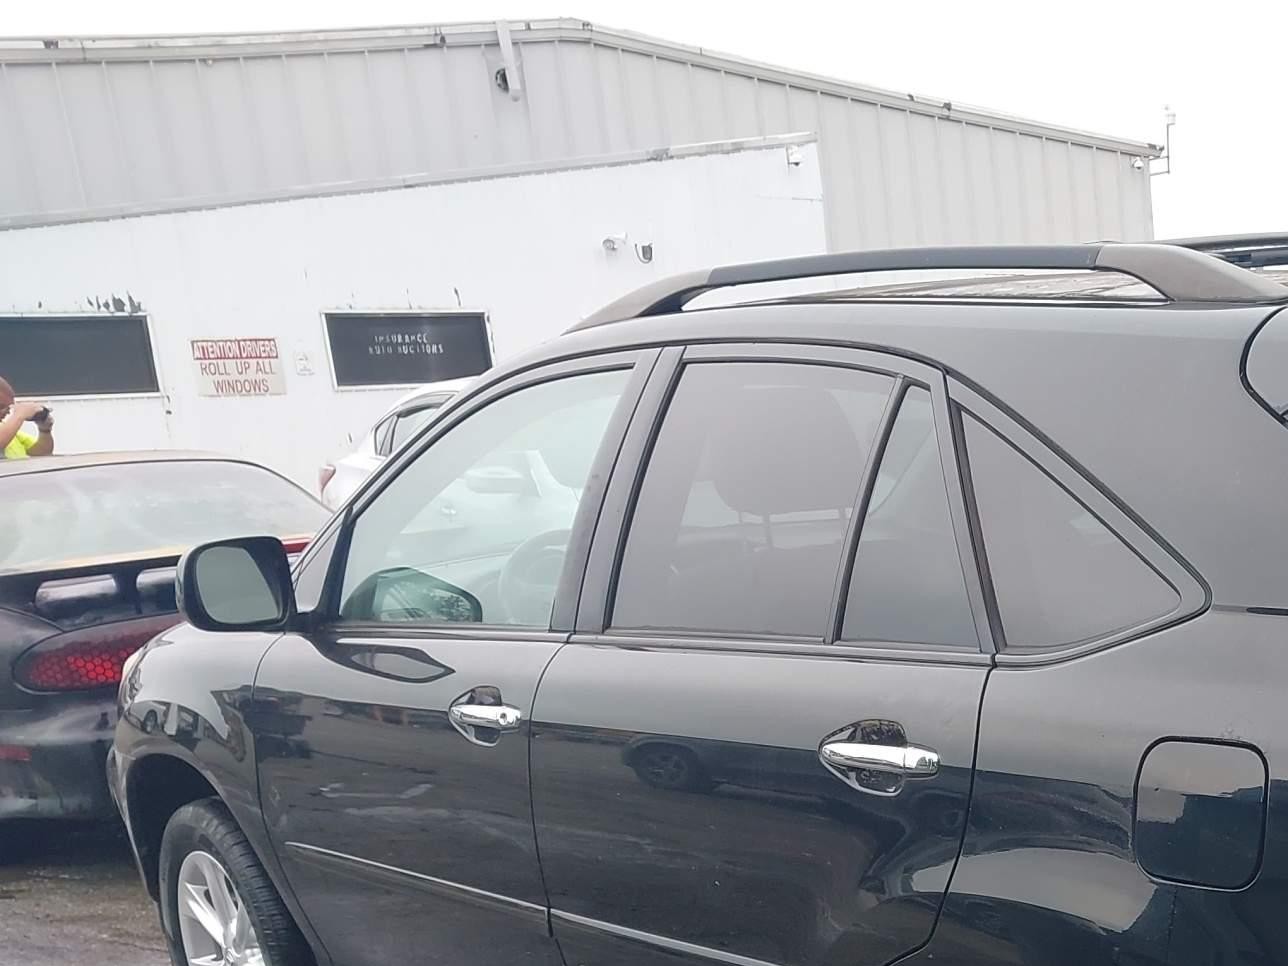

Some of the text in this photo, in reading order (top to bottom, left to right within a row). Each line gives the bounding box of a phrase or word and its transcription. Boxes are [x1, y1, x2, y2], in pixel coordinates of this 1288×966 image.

[193, 340, 277, 359] ATTENTION DRIVERS
[200, 360, 276, 377] ROLL UP ALL
[213, 378, 270, 394] WINDOWS
